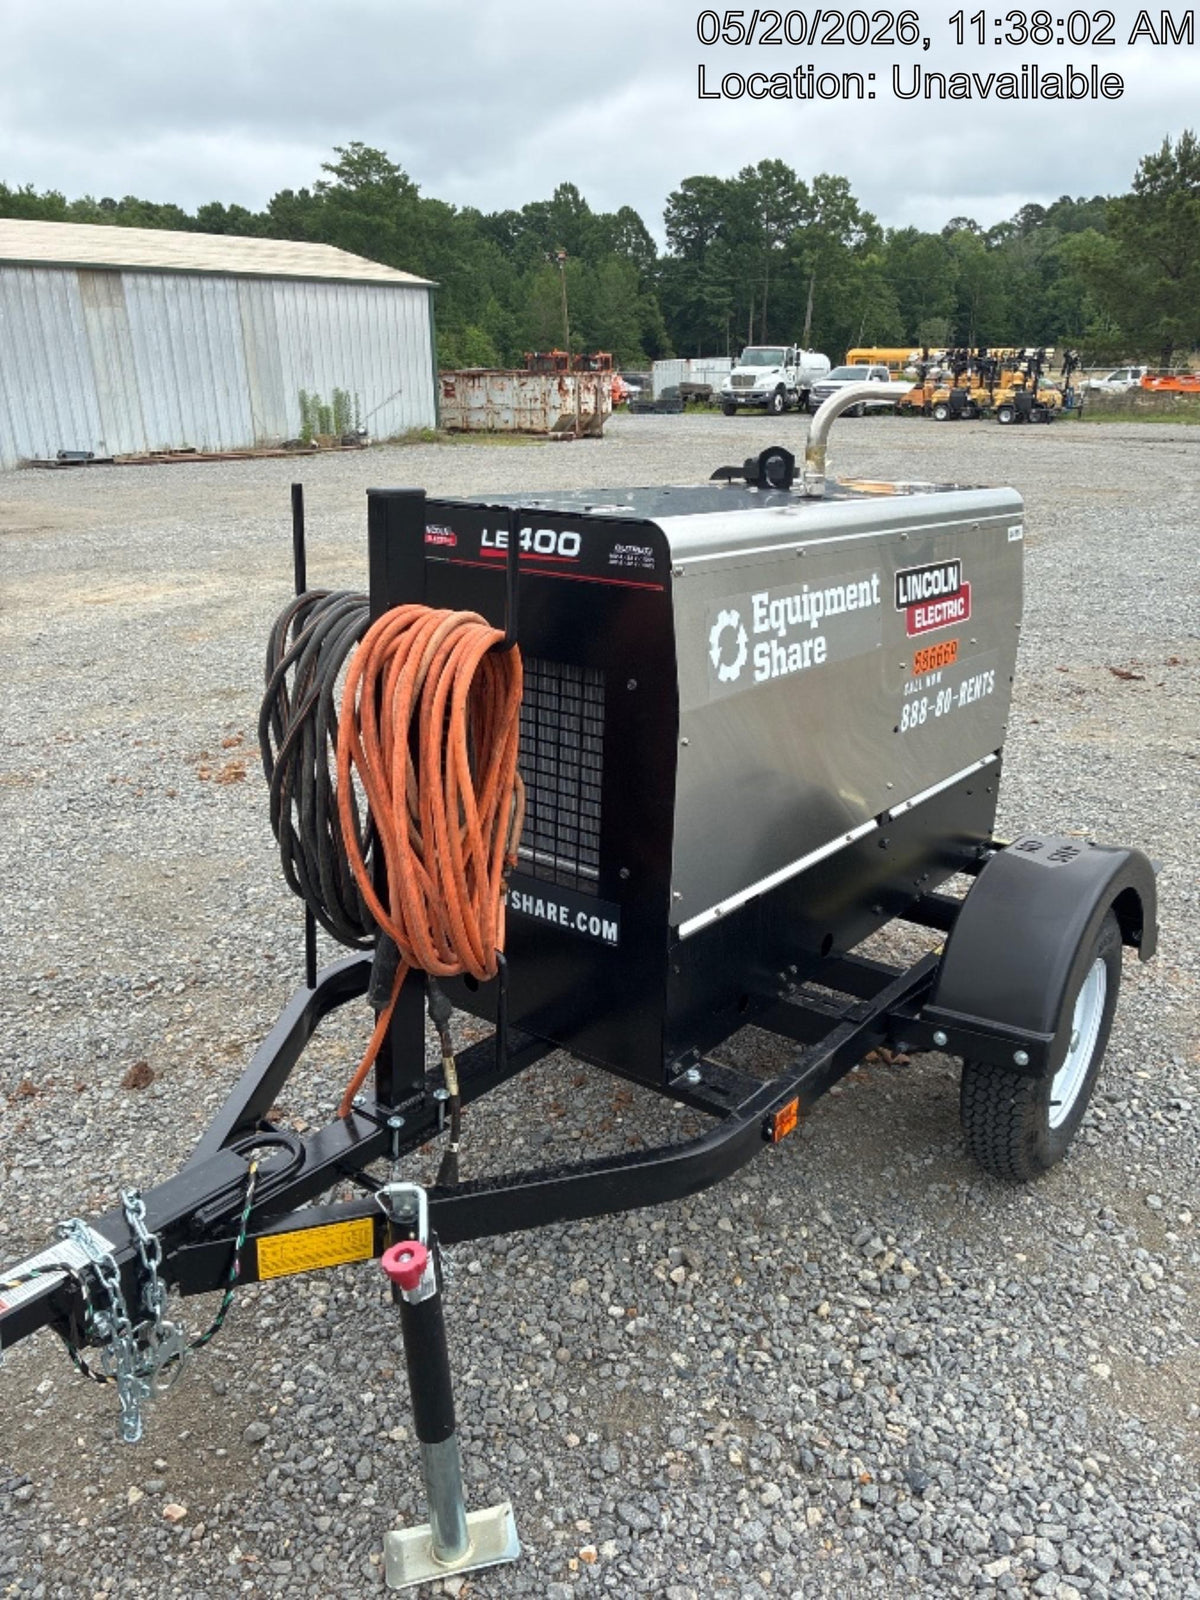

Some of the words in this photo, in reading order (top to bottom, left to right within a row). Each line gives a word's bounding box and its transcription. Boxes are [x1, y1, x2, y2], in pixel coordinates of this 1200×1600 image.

[752, 572, 880, 637] Equipment
[899, 565, 958, 604] LINCOLN
[914, 597, 965, 629] ELECTRIC
[753, 636, 827, 682] Share
[900, 669, 995, 733] 888-80-RENTS
